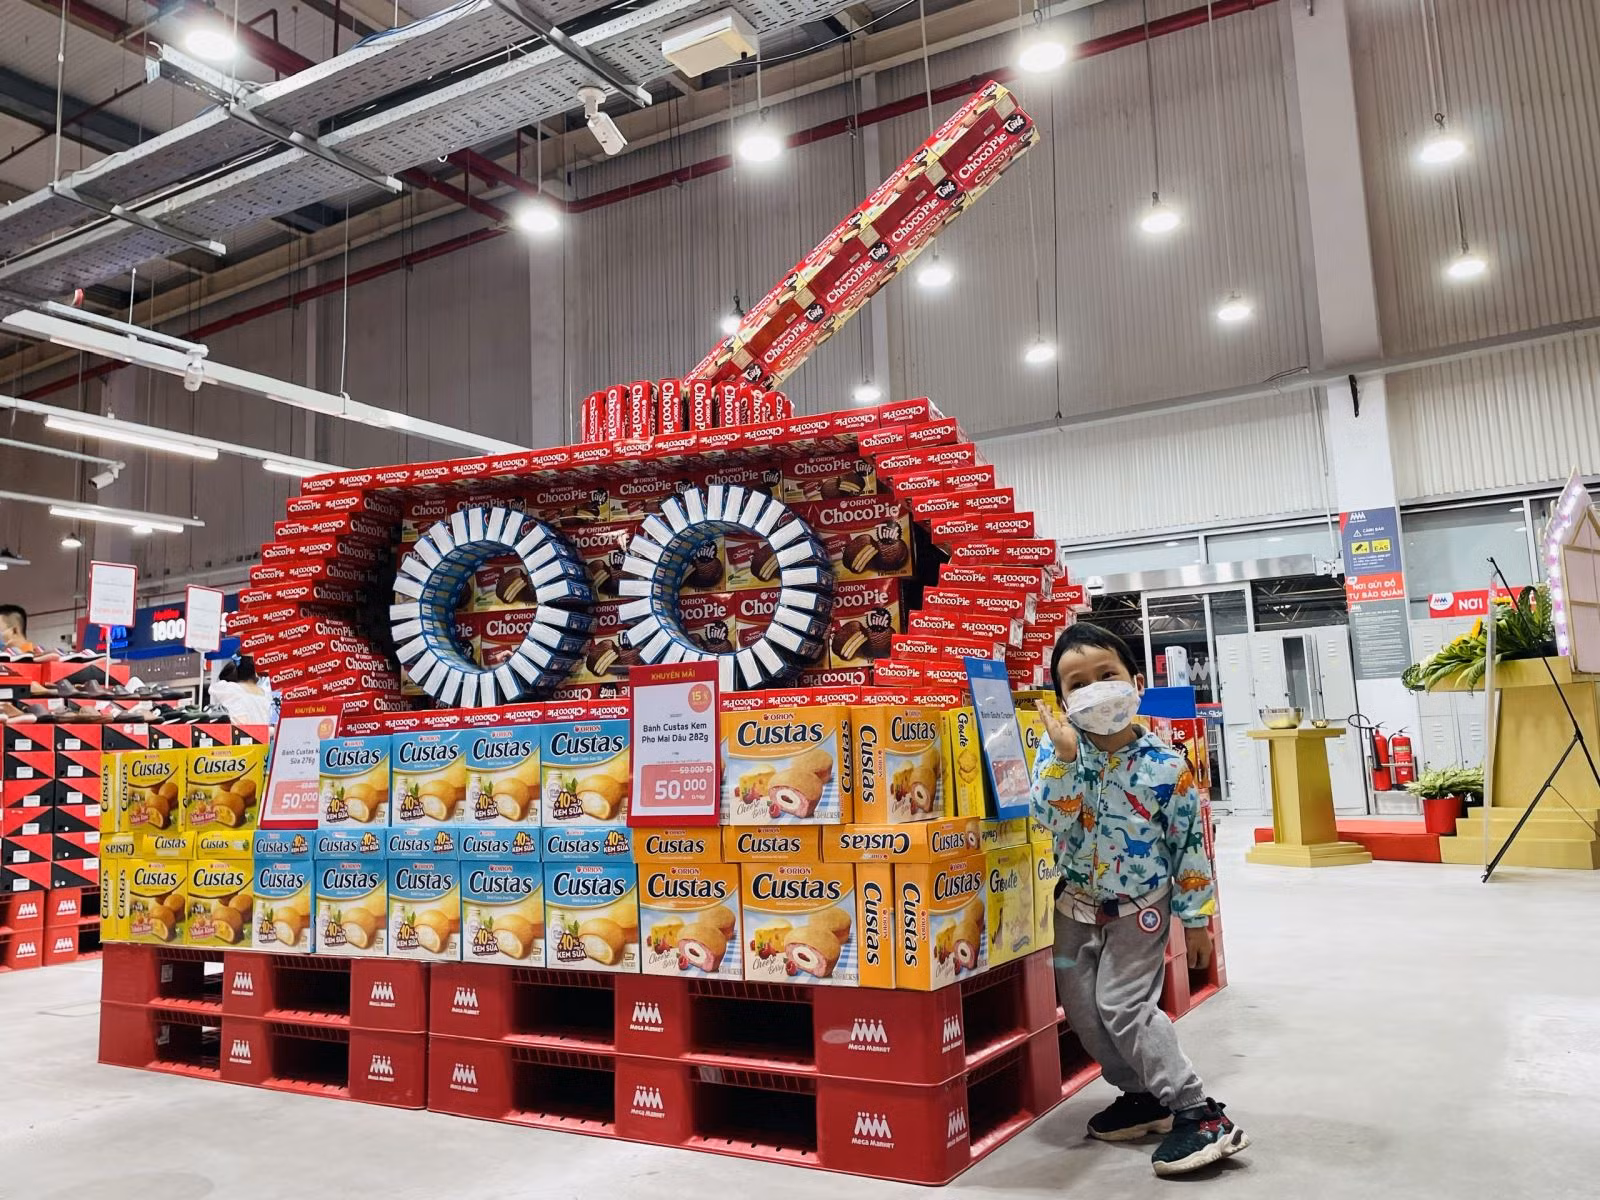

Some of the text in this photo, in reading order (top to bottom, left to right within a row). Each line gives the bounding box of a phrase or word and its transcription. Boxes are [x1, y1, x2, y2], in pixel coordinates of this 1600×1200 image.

[959, 132, 1007, 178] ChocoPie
[892, 198, 939, 242] ChocoPie
[827, 260, 872, 303] ChocoPie
[764, 322, 809, 363] ChocoPie
[883, 405, 925, 419] ChocoPie
[910, 425, 953, 439] ChocoPie
[862, 435, 903, 447] ChocoPie
[794, 460, 850, 474] ChocoPie
[881, 457, 922, 469] ChocoPie
[705, 470, 758, 486] ChocoPie
[898, 479, 940, 491] ChocoPie
[537, 490, 587, 504] ChocoPie
[850, 499, 876, 507] ORION
[289, 501, 321, 512] ChocoPie
[820, 504, 899, 524] ChocoPie
[917, 501, 959, 513] ChocoPie
[936, 523, 979, 535] ChocoPie
[985, 519, 1029, 529] ChocoPie
[264, 547, 295, 558] ChocoPie
[956, 547, 1000, 557] ChocoPie
[1007, 547, 1051, 556] ChocoPie
[943, 572, 986, 582] ChocoPie
[241, 592, 272, 603] ChocoPie
[928, 595, 970, 606] ChocoPie
[977, 597, 1022, 609] ChocoPie
[1458, 597, 1483, 611] NƠI
[228, 615, 258, 627] ChocoPie
[913, 619, 955, 630] ChocoPie
[896, 643, 937, 653] ChocoPie
[257, 652, 288, 665] ChocoPie
[272, 669, 303, 683] ChocoPie
[878, 668, 920, 678] ChocoPie
[285, 687, 317, 700] ChocoPie
[642, 735, 655, 743] Pho
[689, 733, 708, 742] 282g
[738, 721, 823, 746] Custas
[892, 719, 936, 742] Custas
[399, 741, 458, 763] Custas
[473, 737, 530, 760] Custas
[551, 733, 623, 755] Custas
[194, 755, 246, 774] Custas
[325, 747, 380, 769] Custas
[841, 720, 849, 794] Custas
[860, 725, 877, 803] Custas
[132, 759, 170, 777] Custas
[101, 763, 109, 813] Custas
[155, 836, 186, 850] Custas
[201, 838, 228, 851] Custas
[256, 839, 289, 854] Custas
[319, 838, 357, 852] Custas
[389, 837, 430, 852] Custas
[463, 837, 508, 854] Custas
[547, 835, 599, 854] Custas
[646, 835, 704, 854] Custas
[738, 834, 800, 853] Custas
[840, 833, 910, 854] Custas
[932, 831, 964, 852] Custas
[135, 869, 176, 887] Custas
[194, 868, 243, 887] Custas
[260, 868, 303, 889] Custas
[323, 867, 378, 889] Custas
[396, 867, 451, 891] Custas
[469, 871, 531, 894] Custas
[554, 873, 625, 898] Custas
[648, 874, 726, 898] Custas
[753, 872, 841, 899] Custas
[934, 868, 981, 900] Custas
[118, 870, 127, 919] Custas
[864, 882, 882, 966] Custas
[902, 882, 921, 967] Custas
